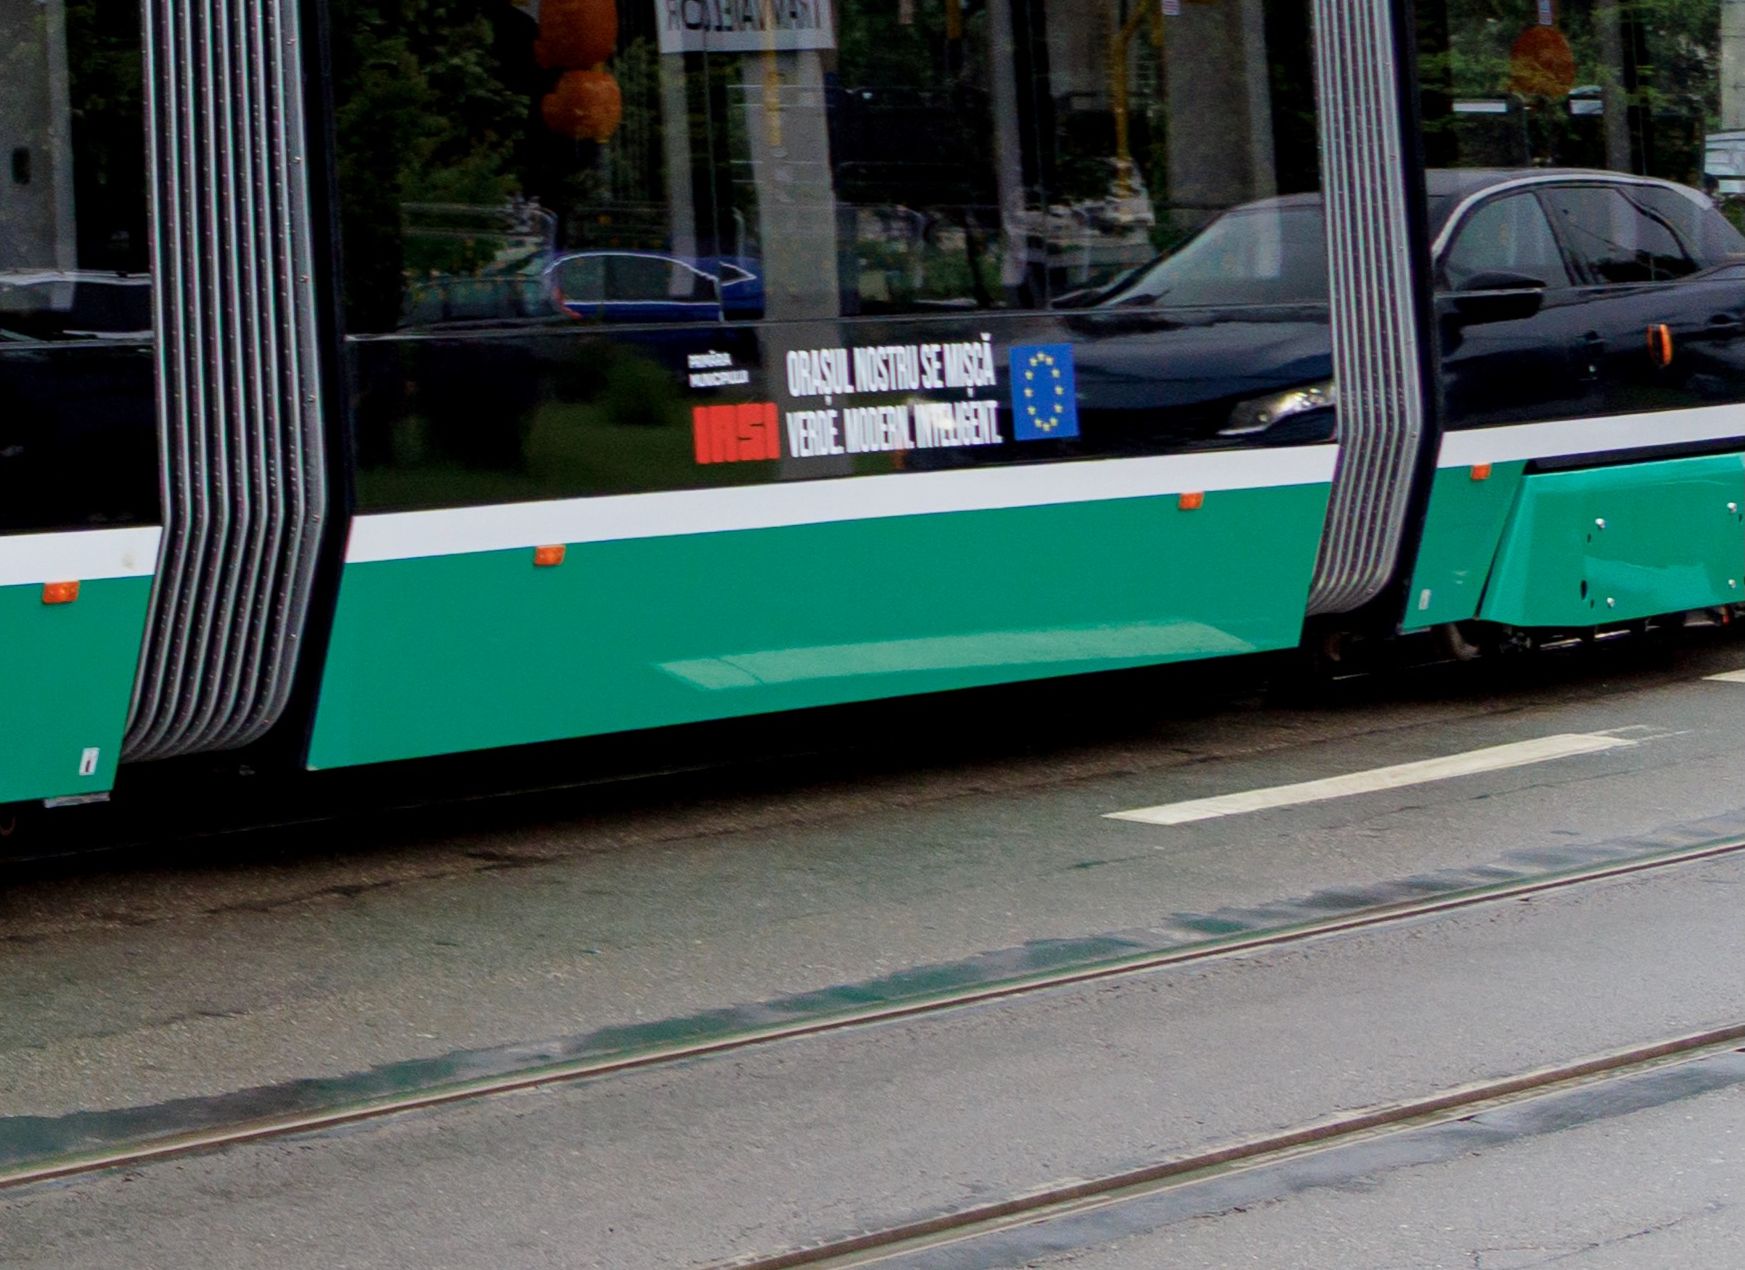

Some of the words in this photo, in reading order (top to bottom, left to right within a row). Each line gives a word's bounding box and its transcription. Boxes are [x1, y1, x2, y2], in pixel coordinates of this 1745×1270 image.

[786, 347, 854, 406] ORAȘUL
[853, 344, 920, 393] NOSTRU
[920, 342, 945, 390] SE
[944, 332, 997, 398] MIȘCĂ
[785, 409, 844, 458] VERDE.
[843, 404, 914, 454] MODERN.
[914, 400, 1004, 450] INTELIGENT.
